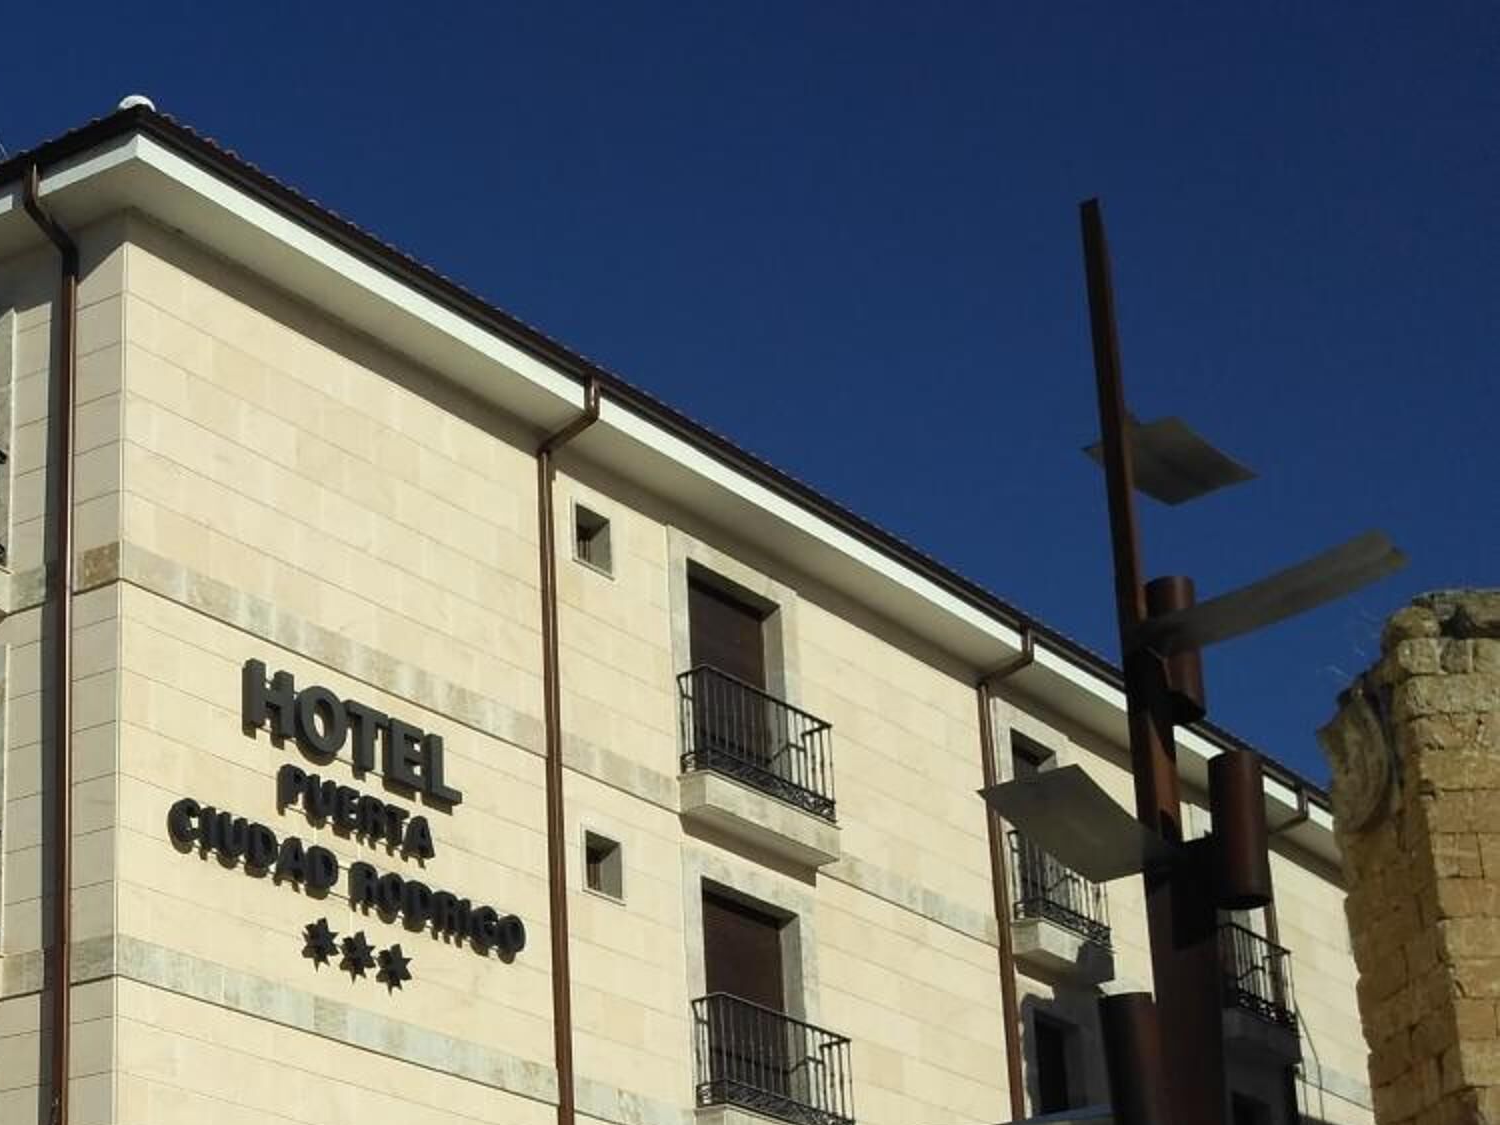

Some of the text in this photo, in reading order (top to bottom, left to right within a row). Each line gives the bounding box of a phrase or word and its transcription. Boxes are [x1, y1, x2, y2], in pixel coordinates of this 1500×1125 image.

[242, 658, 462, 806] HOTEL
[167, 798, 526, 957] CIUDAD RODRIGO
[277, 764, 436, 862] PUERTA
